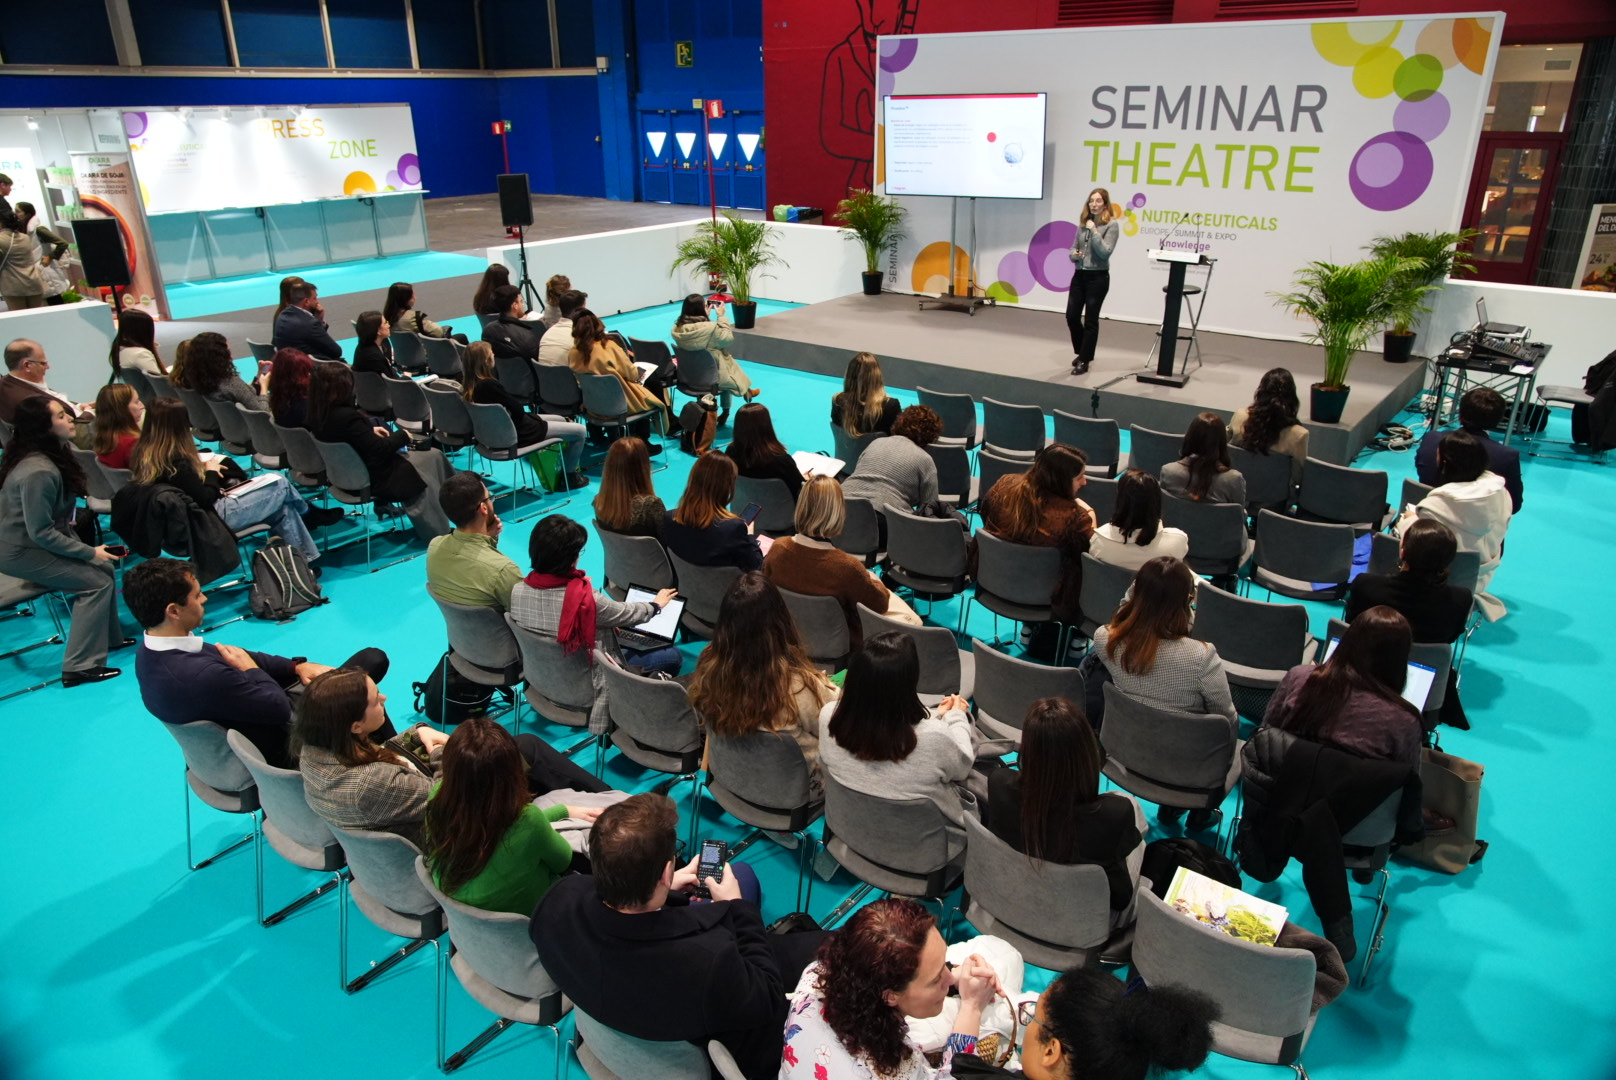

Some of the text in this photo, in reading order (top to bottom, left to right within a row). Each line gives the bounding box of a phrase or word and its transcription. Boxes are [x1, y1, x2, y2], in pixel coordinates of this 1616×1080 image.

[1088, 84, 1328, 133] SEMINAR
[257, 118, 325, 139] PRESS
[328, 139, 378, 159] ZONE
[1083, 140, 1321, 193] THEATRE
[1142, 209, 1279, 231] NUTRACEUTICALS
[1140, 226, 1169, 236] EUROPE
[1174, 229, 1206, 239] SUMMIT
[1215, 232, 1237, 241] EXPO
[1159, 238, 1211, 252] Knowledge
[888, 233, 898, 284] SEMINAR
